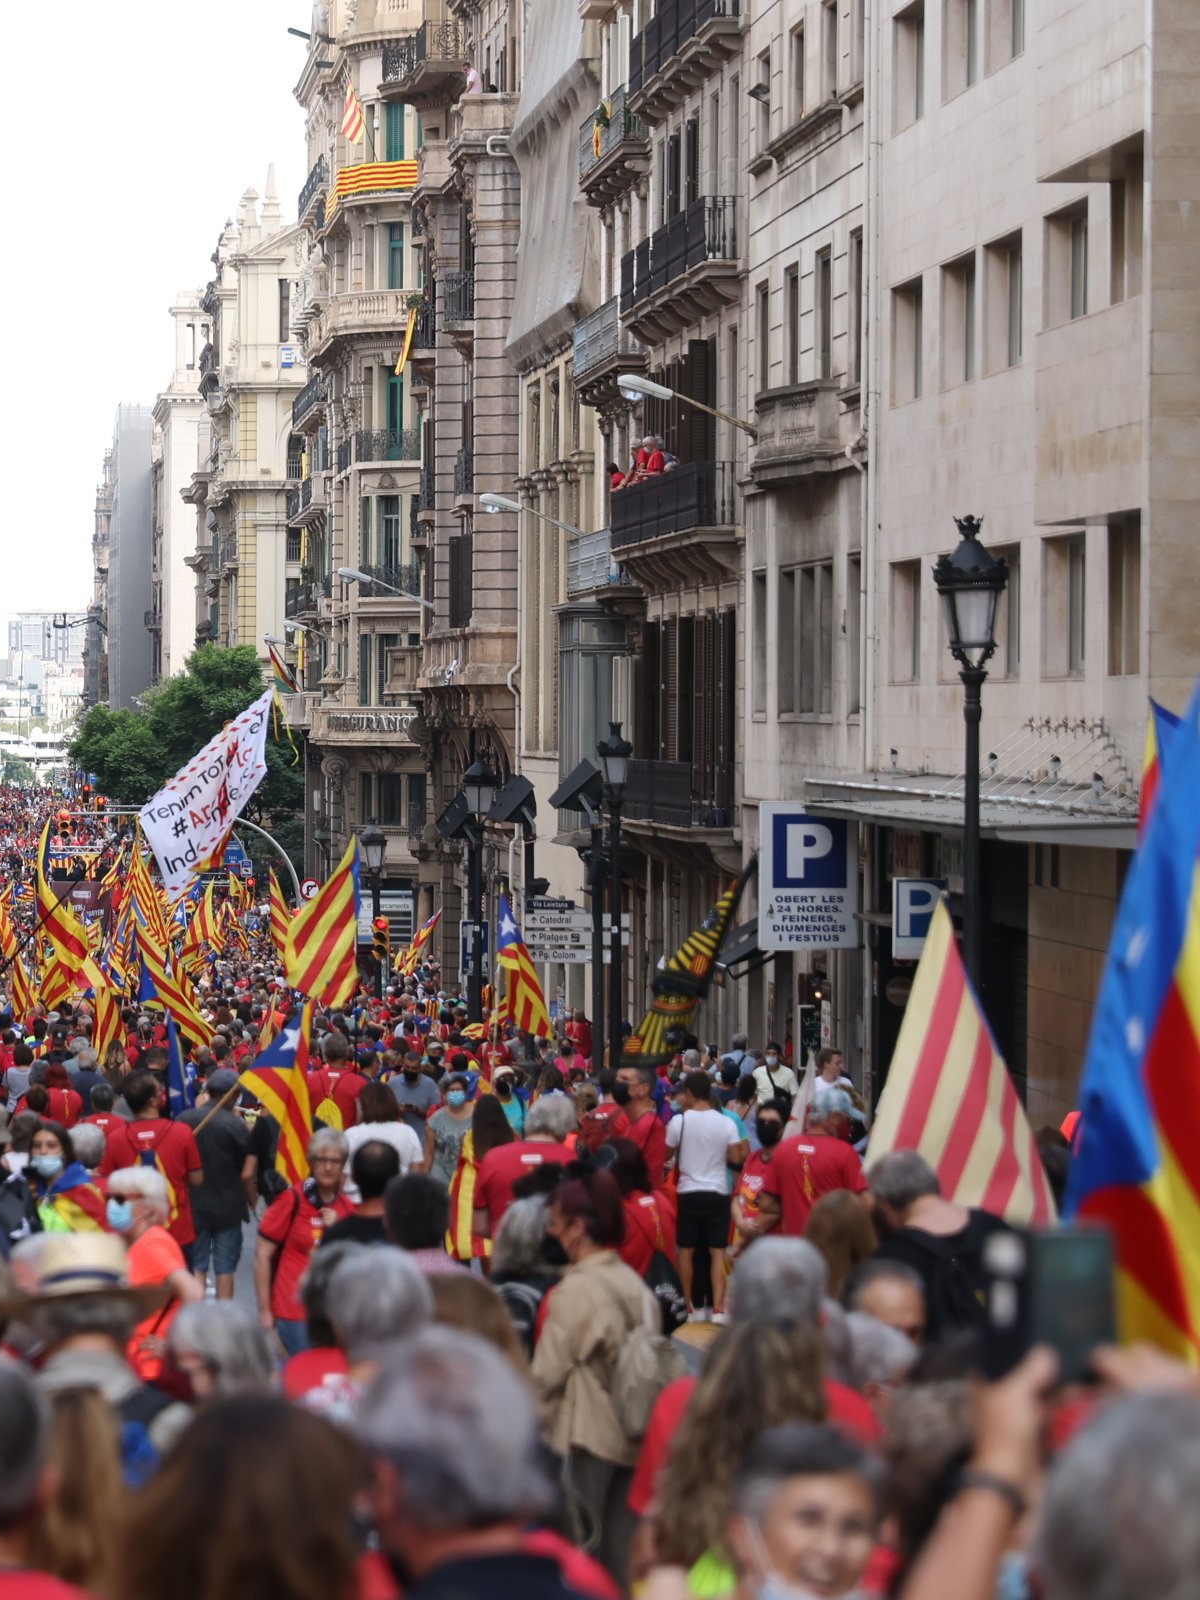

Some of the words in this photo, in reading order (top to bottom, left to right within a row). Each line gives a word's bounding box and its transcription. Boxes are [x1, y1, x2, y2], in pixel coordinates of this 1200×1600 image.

[144, 784, 201, 824] Tenim
[786, 823, 833, 879] P
[775, 895, 816, 903] OBERT
[822, 895, 844, 903] LES
[898, 882, 941, 936] P
[539, 916, 572, 924] Catedral
[782, 915, 837, 923] FEINERS,
[539, 932, 568, 942] Platges
[778, 934, 782, 942] I
[788, 934, 840, 942] FESTIUS
[539, 951, 550, 959] Pg.
[552, 950, 576, 959] Colom
